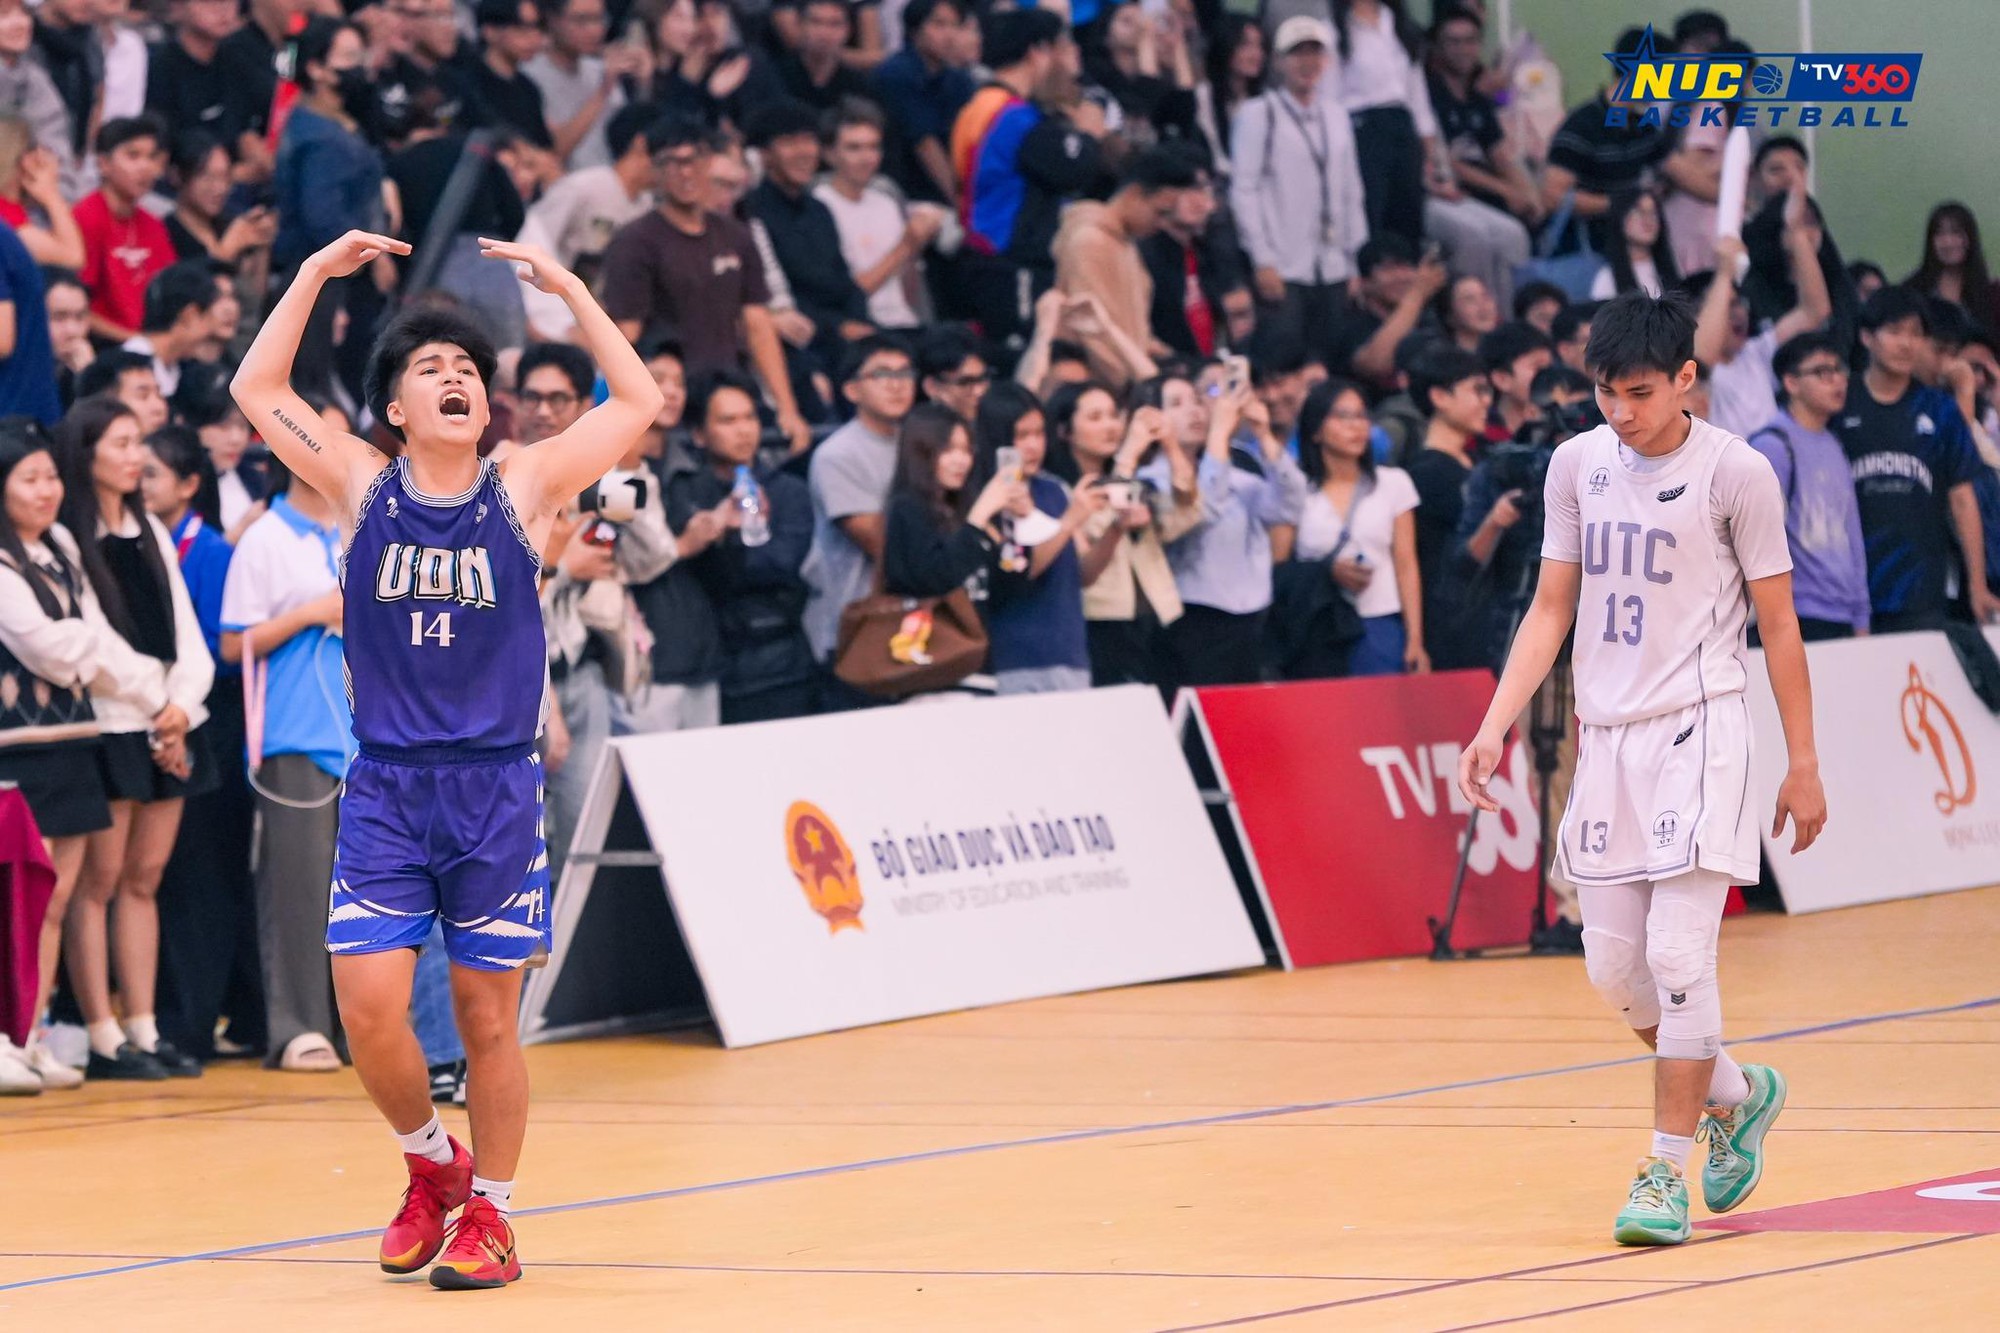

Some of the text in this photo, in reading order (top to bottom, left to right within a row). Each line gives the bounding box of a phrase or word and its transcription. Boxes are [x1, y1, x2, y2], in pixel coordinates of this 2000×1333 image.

[272, 409, 322, 455] BASKETBALL
[377, 543, 496, 608] UDN
[1585, 521, 1677, 585] UTC
[410, 611, 455, 647] 14
[1602, 593, 1644, 646] 13
[1579, 819, 1608, 854] 13
[526, 886, 546, 924] 14
